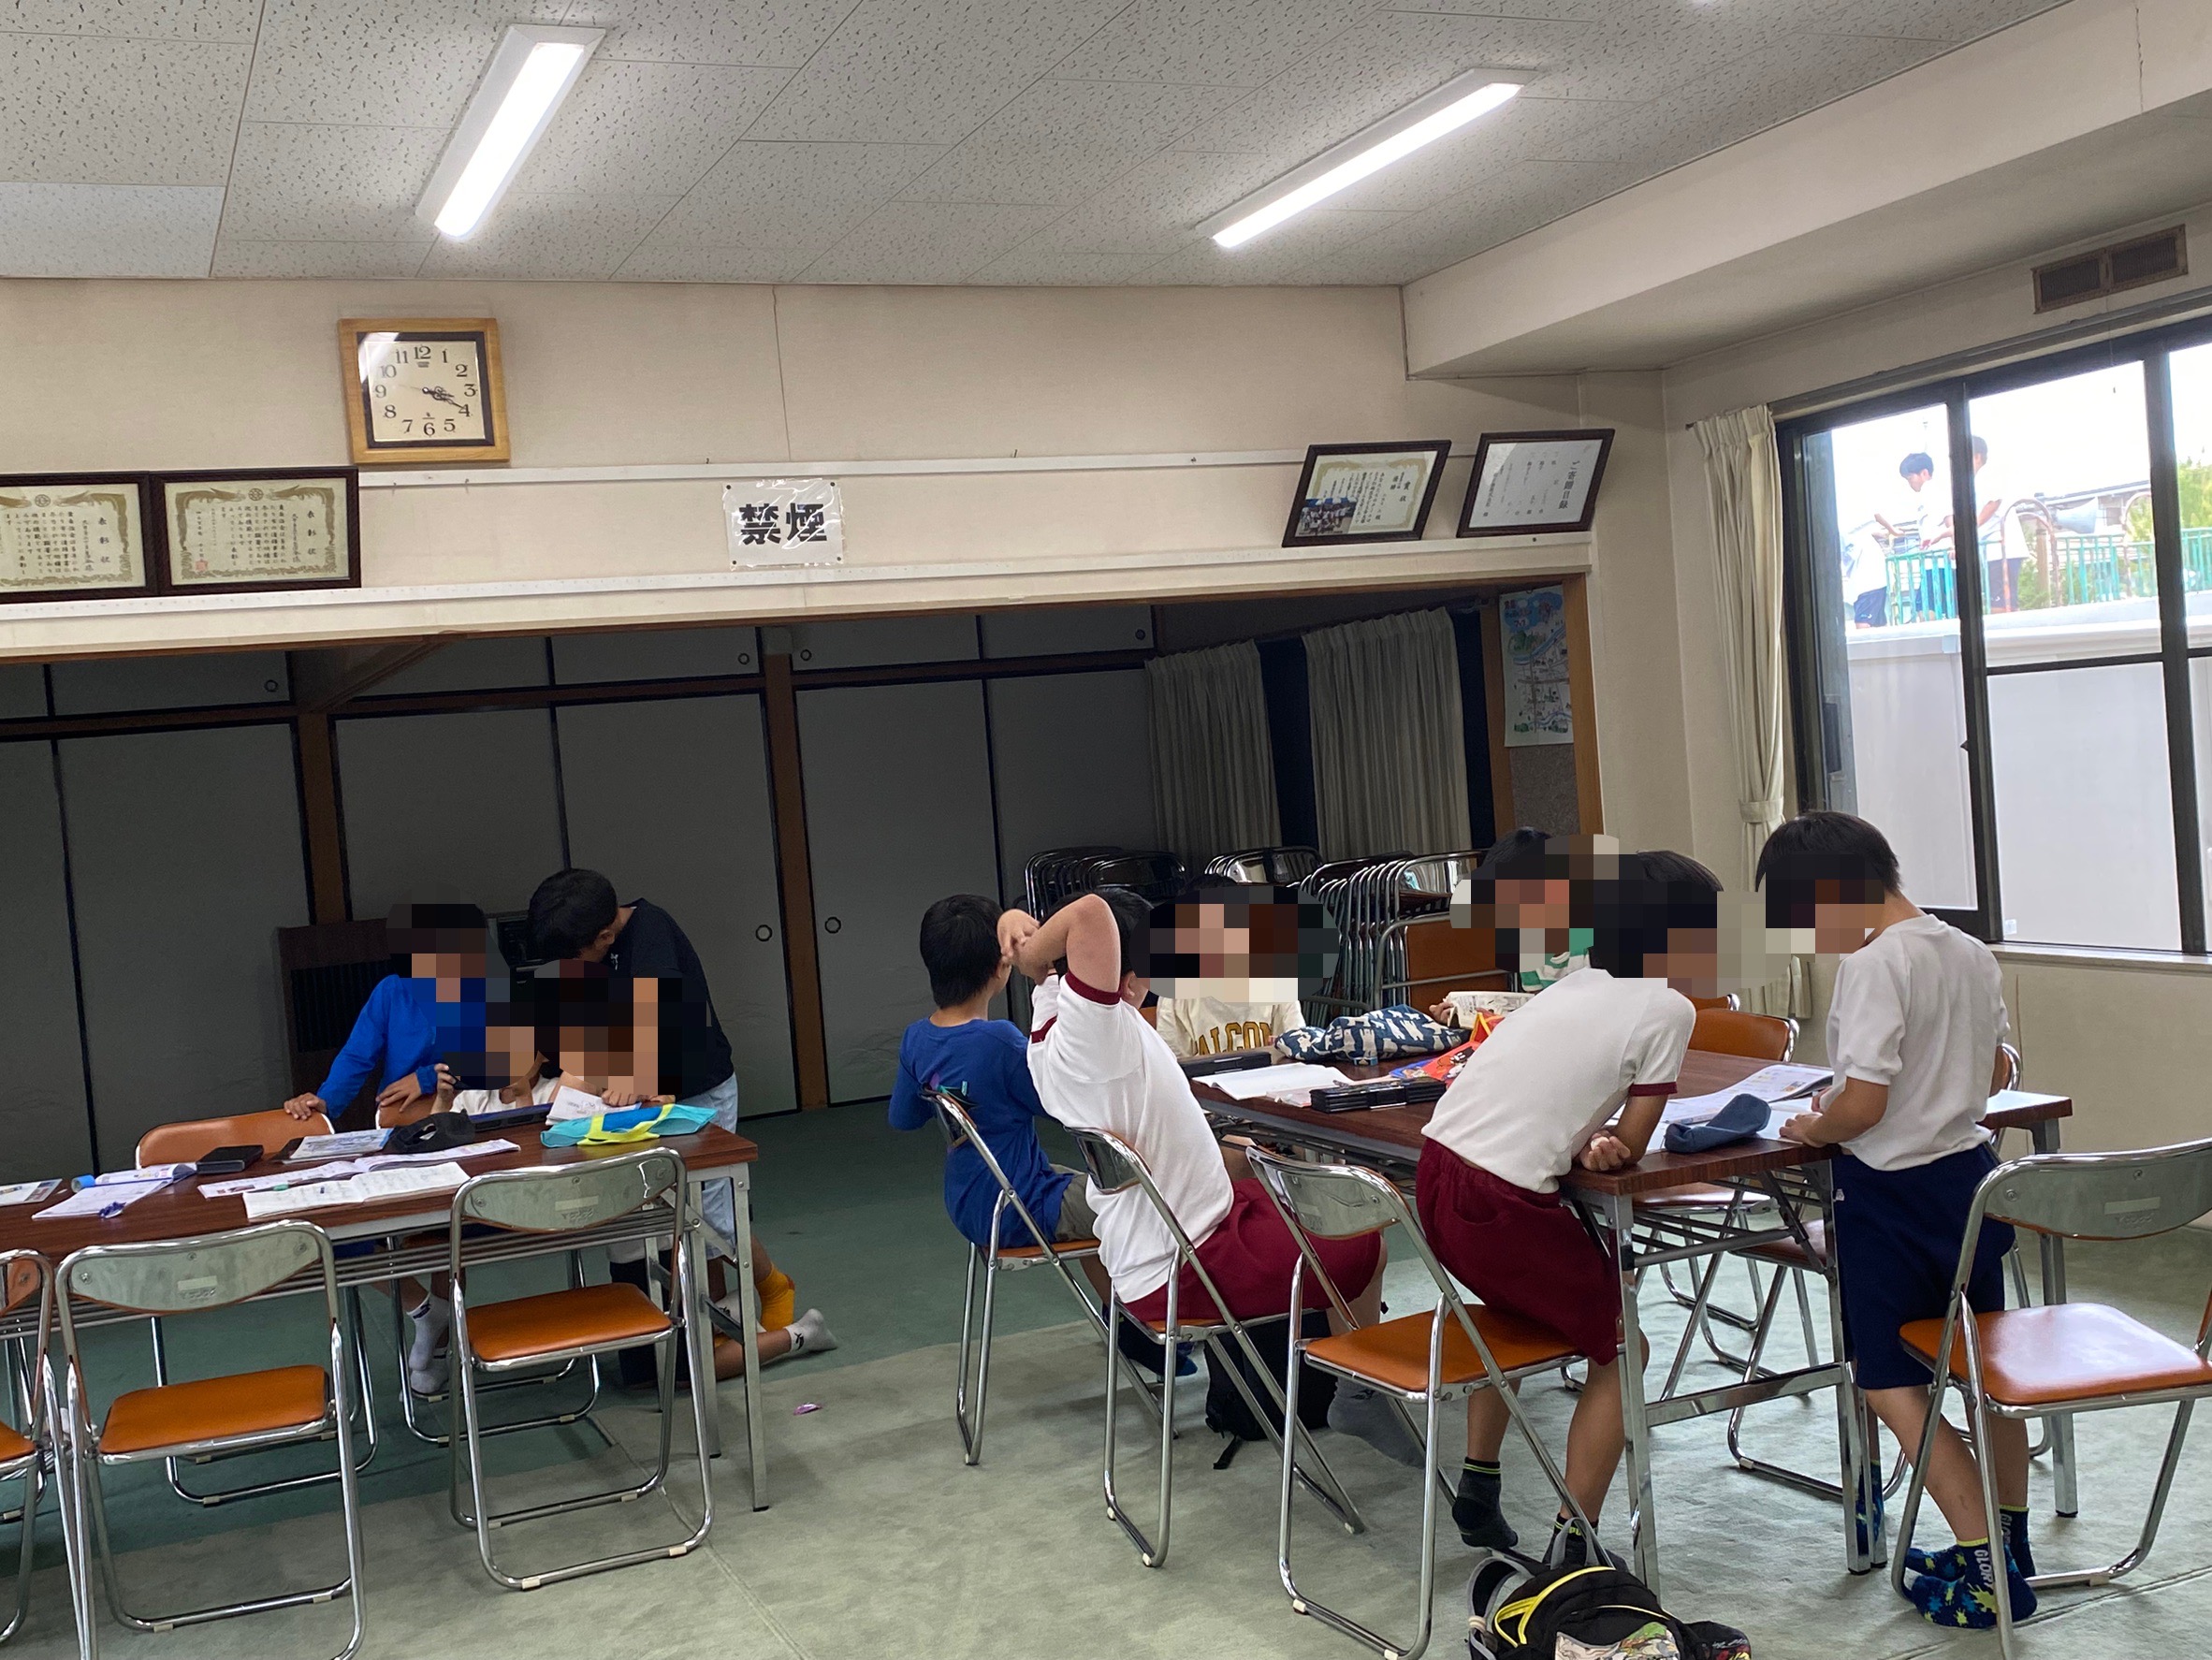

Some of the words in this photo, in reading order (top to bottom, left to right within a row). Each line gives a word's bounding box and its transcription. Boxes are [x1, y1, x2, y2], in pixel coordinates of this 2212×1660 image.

[396, 349, 409, 364] 11
[414, 346, 431, 360] 12
[442, 349, 448, 363] 1
[380, 365, 397, 378] 10
[455, 364, 468, 377] 2
[374, 385, 387, 398] 9
[464, 384, 476, 397] 3
[384, 405, 397, 418] 8
[458, 404, 471, 417] 4
[402, 419, 414, 432] 7
[423, 422, 435, 436] 6
[444, 418, 456, 432] 5
[738, 502, 828, 546] 禁煙
